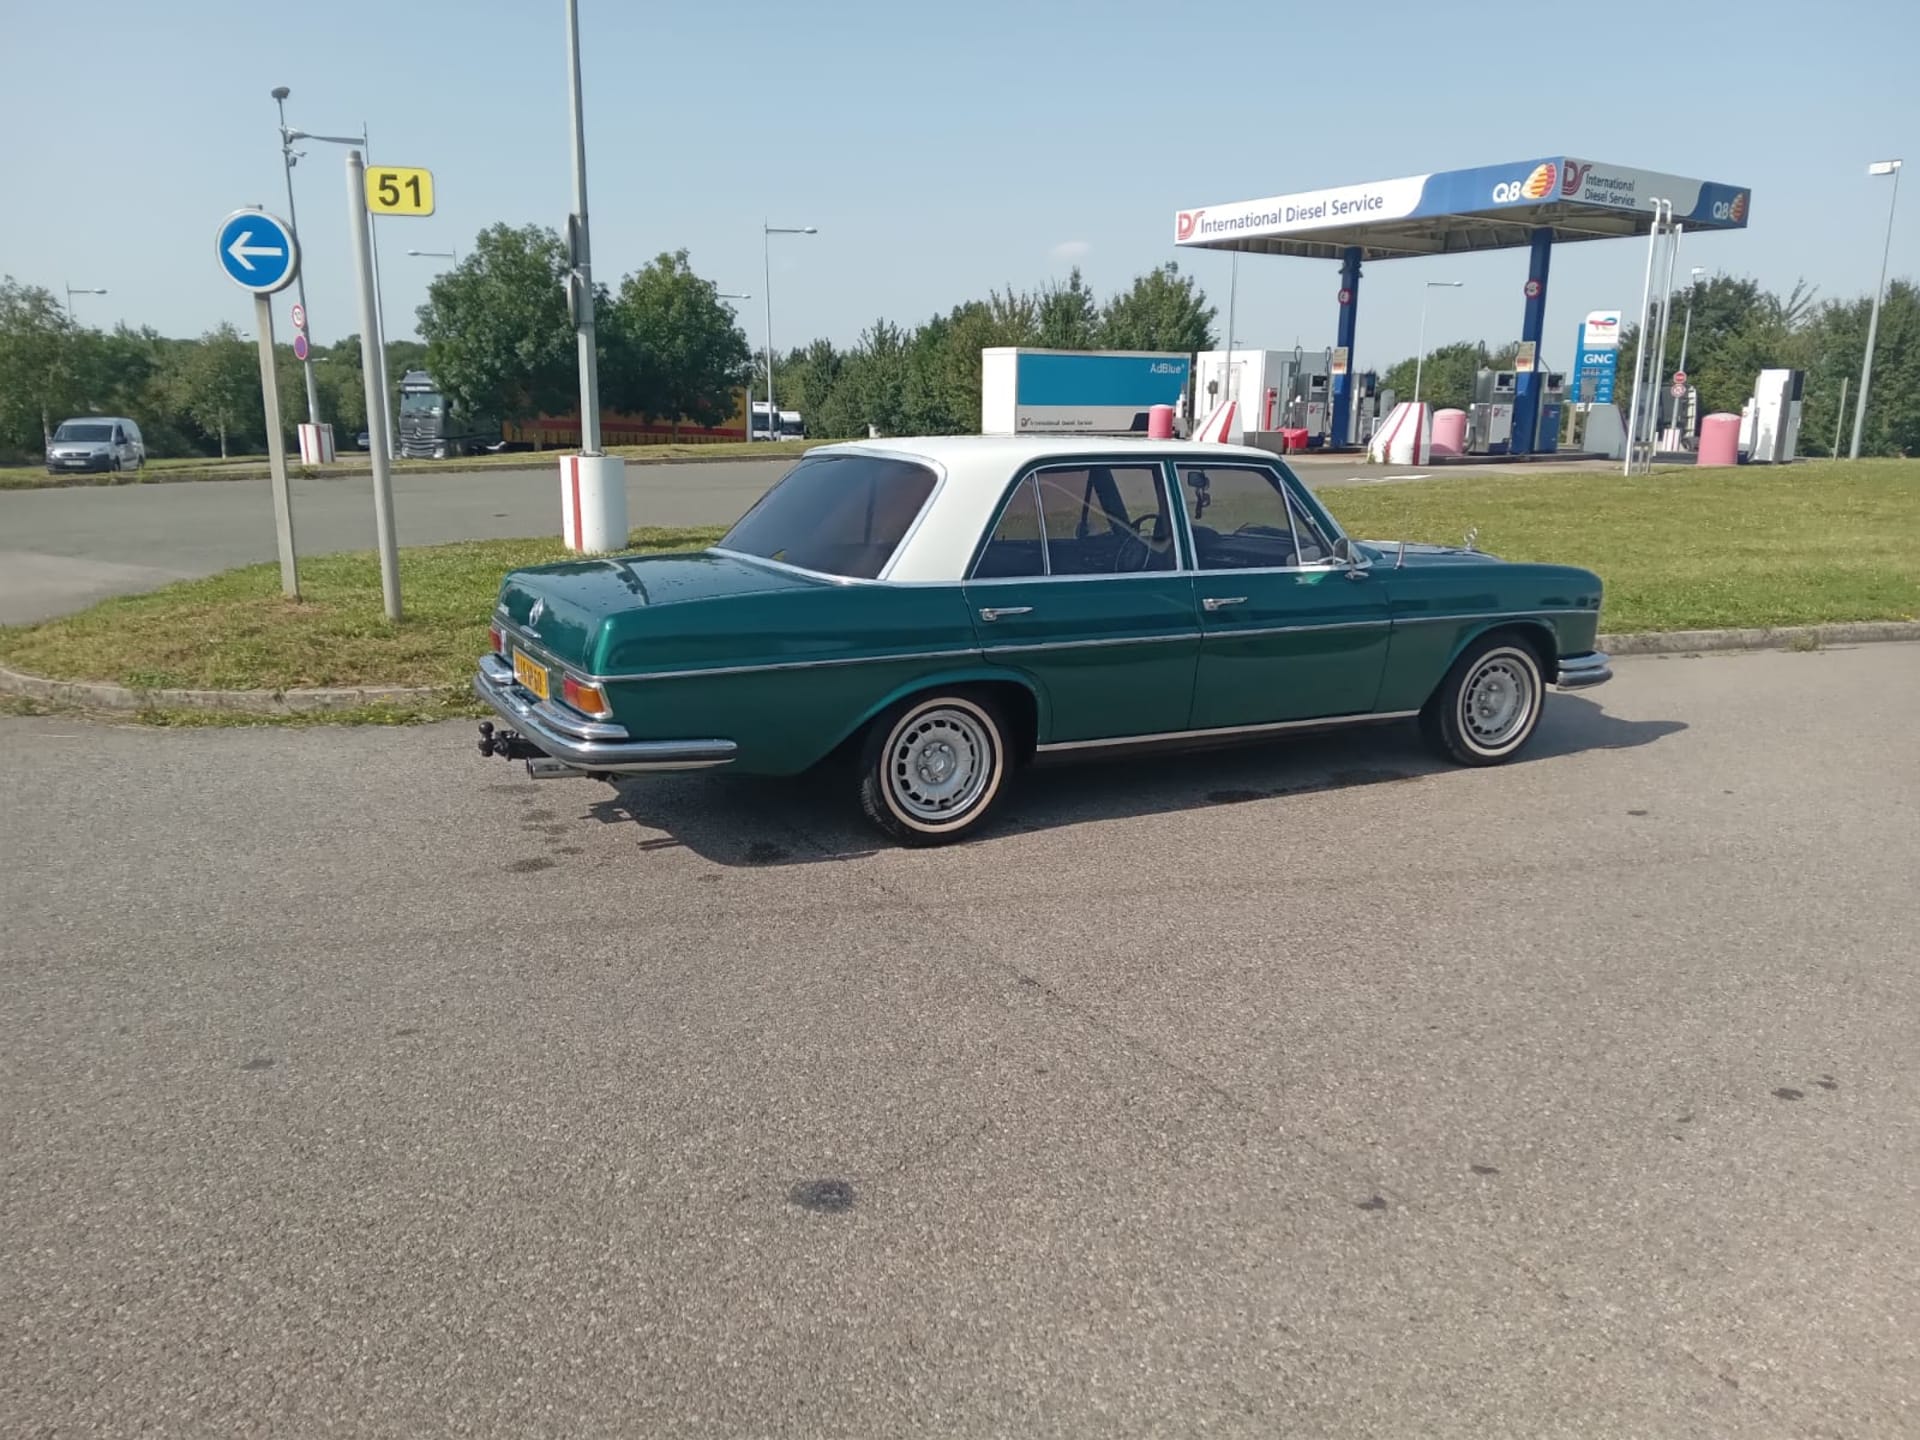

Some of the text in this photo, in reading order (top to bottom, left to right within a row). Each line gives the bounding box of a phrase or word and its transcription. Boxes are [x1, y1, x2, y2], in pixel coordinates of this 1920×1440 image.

[379, 174, 421, 207] 51
[1492, 181, 1521, 203] Q8
[1586, 173, 1635, 192] International
[1585, 188, 1636, 207] Diesel Service
[1201, 207, 1281, 233] International
[1286, 201, 1326, 223] Diesel
[1331, 194, 1384, 216] Service
[1712, 202, 1729, 220] Q8
[1583, 353, 1614, 364] GNC
